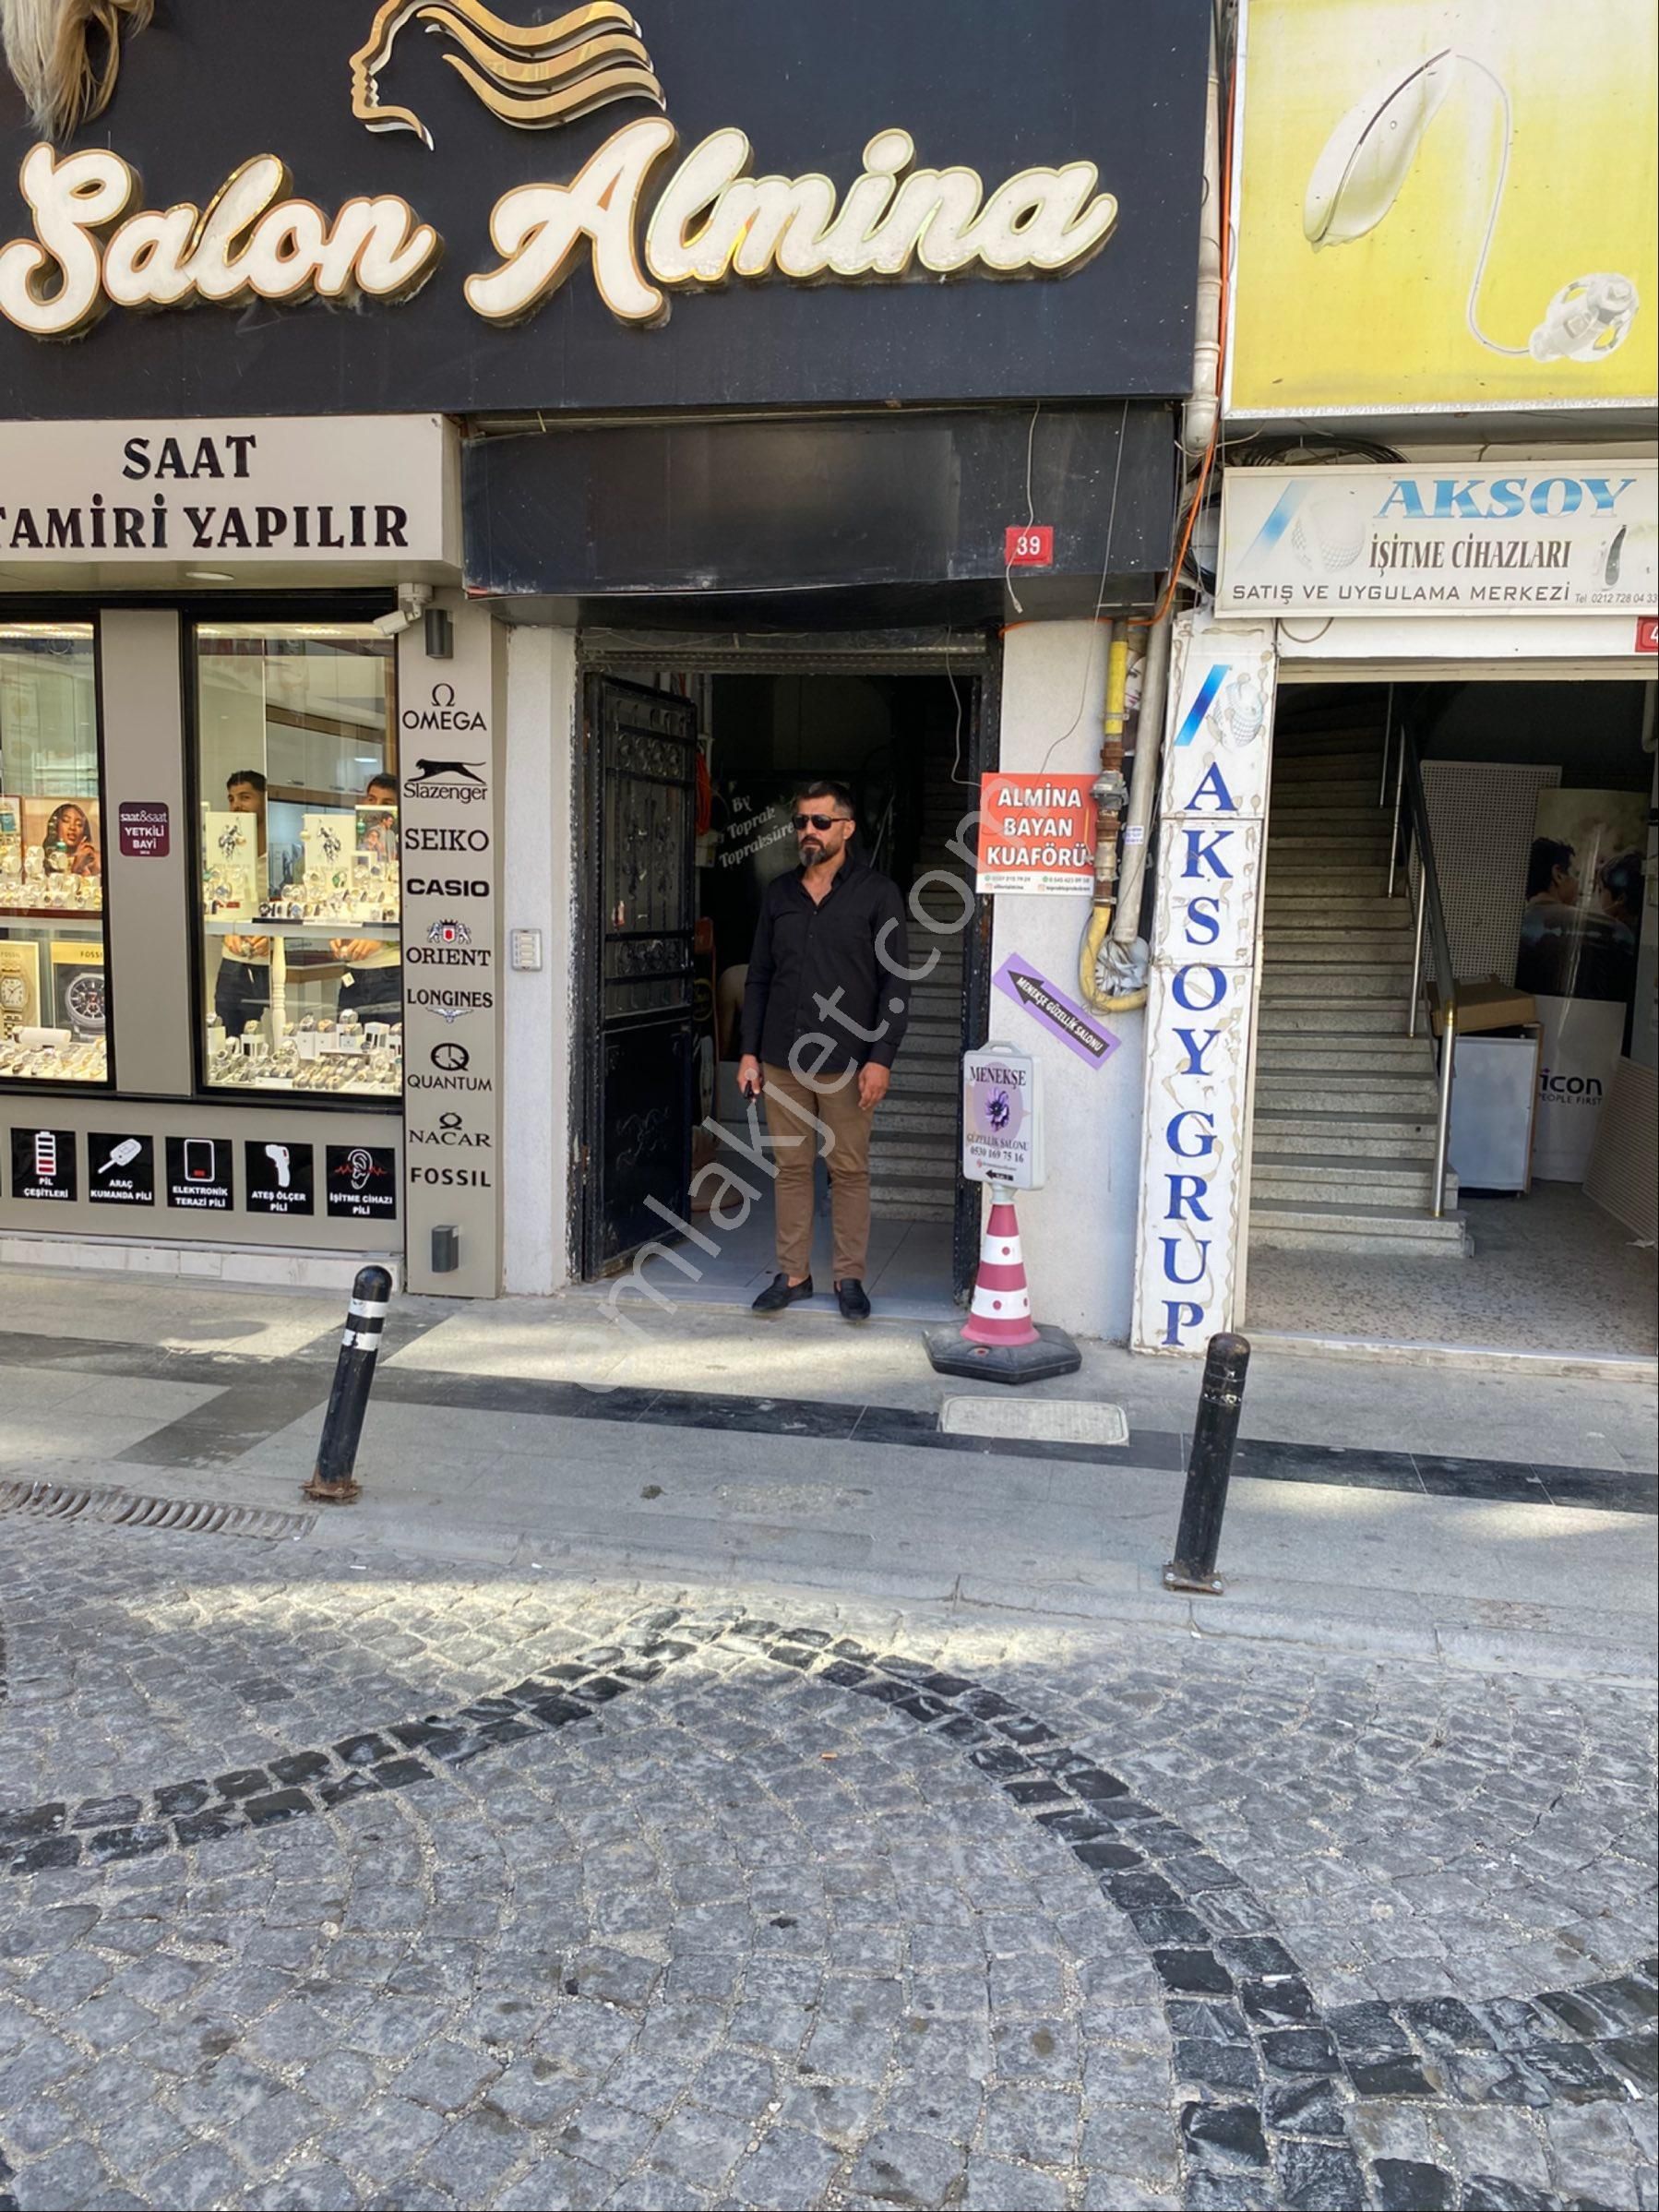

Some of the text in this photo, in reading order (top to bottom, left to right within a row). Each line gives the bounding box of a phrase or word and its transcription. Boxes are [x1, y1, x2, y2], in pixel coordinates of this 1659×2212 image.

[0, 117, 1118, 335] Salon Almina
[122, 436, 257, 481] SAAT
[1372, 478, 1637, 520] AKSOY
[184, 506, 408, 547] YAPILIR
[1017, 535, 1041, 556] 39
[1369, 532, 1572, 576] İŞİTME CİHAZLARI
[1232, 580, 1570, 604] SATIŞ VE UYGULAMA MERKEZİ
[1592, 593, 1614, 604] 0212
[1616, 593, 1631, 604] 728
[1633, 594, 1644, 604] 04
[401, 710, 487, 732] OMEGA
[403, 783, 488, 805] Slazenger
[997, 782, 1082, 808] ALMİNA
[125, 824, 164, 838] YETKİLİ
[727, 805, 776, 840] Toprak
[1003, 817, 1073, 838] BAYAN
[132, 837, 157, 850] BAYİ
[405, 829, 489, 852] SEIKO
[986, 842, 1087, 867] KUAFÖRÜ
[406, 879, 490, 897] CASIO
[406, 947, 492, 966] ORIENT
[407, 988, 494, 1009] LONGINES
[1016, 976, 1104, 1052] MENEKŞE GÜZELLİK SALONU
[407, 1074, 493, 1092] QUANTUM
[969, 1065, 1027, 1090] MENEKŞE
[1576, 1096, 1603, 1106] FIRST
[409, 1130, 493, 1148] NACAR
[970, 1145, 1024, 1163] 0530 169 75 16
[39, 1176, 54, 1187] PİL
[109, 1178, 133, 1190] ARAÇ
[411, 1167, 492, 1188] FOSSIL
[24, 1187, 68, 1199] ÇEŞİTLERİ
[90, 1190, 152, 1202] KUMANDA PİLİ
[173, 1185, 228, 1197] ELEKTRONİK
[251, 1190, 306, 1203] ATEŞ ÖLÇER
[329, 1192, 393, 1205] İŞİTME CİHAZI
[176, 1195, 226, 1209] TERAZİ PİLİ
[269, 1202, 288, 1213] PİLİ
[352, 1205, 370, 1215] PİLİ
